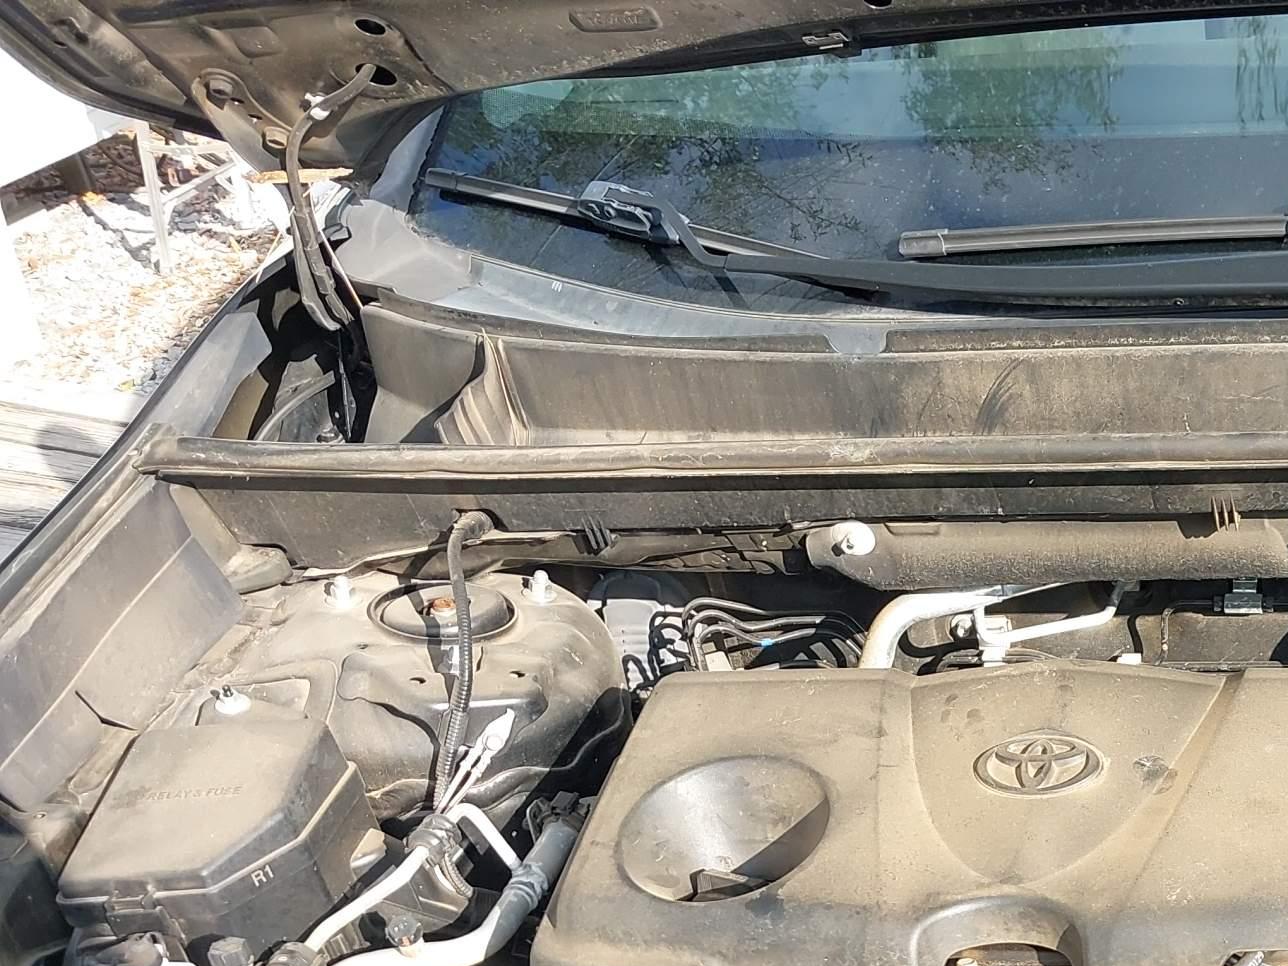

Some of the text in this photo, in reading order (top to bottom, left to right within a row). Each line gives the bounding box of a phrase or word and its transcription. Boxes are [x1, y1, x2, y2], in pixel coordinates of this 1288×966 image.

[147, 790, 189, 801] RELAY
[205, 786, 244, 798] FUSE
[250, 864, 275, 887] R1
